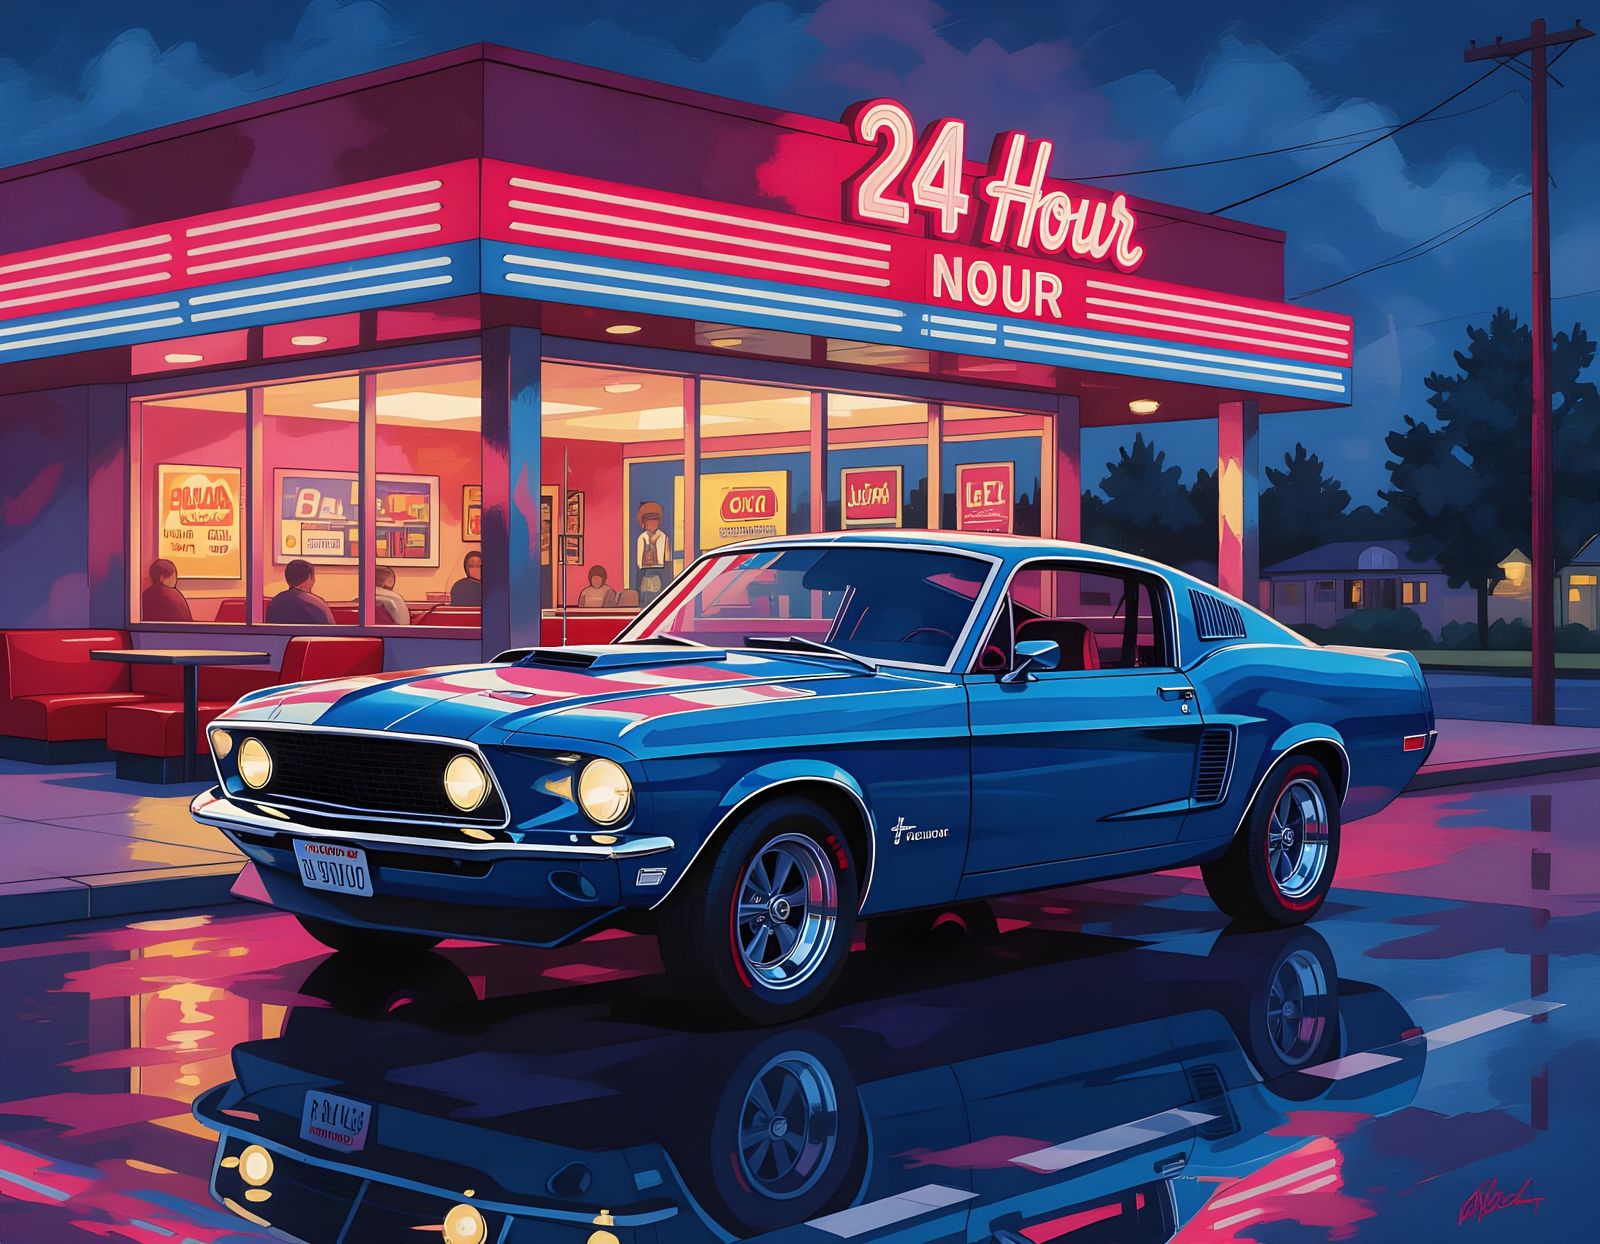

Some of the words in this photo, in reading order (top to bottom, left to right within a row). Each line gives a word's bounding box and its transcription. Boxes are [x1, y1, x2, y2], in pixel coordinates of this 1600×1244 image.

[858, 104, 969, 233] 24
[986, 134, 1143, 267] Hour
[933, 253, 1063, 318] NOUR
